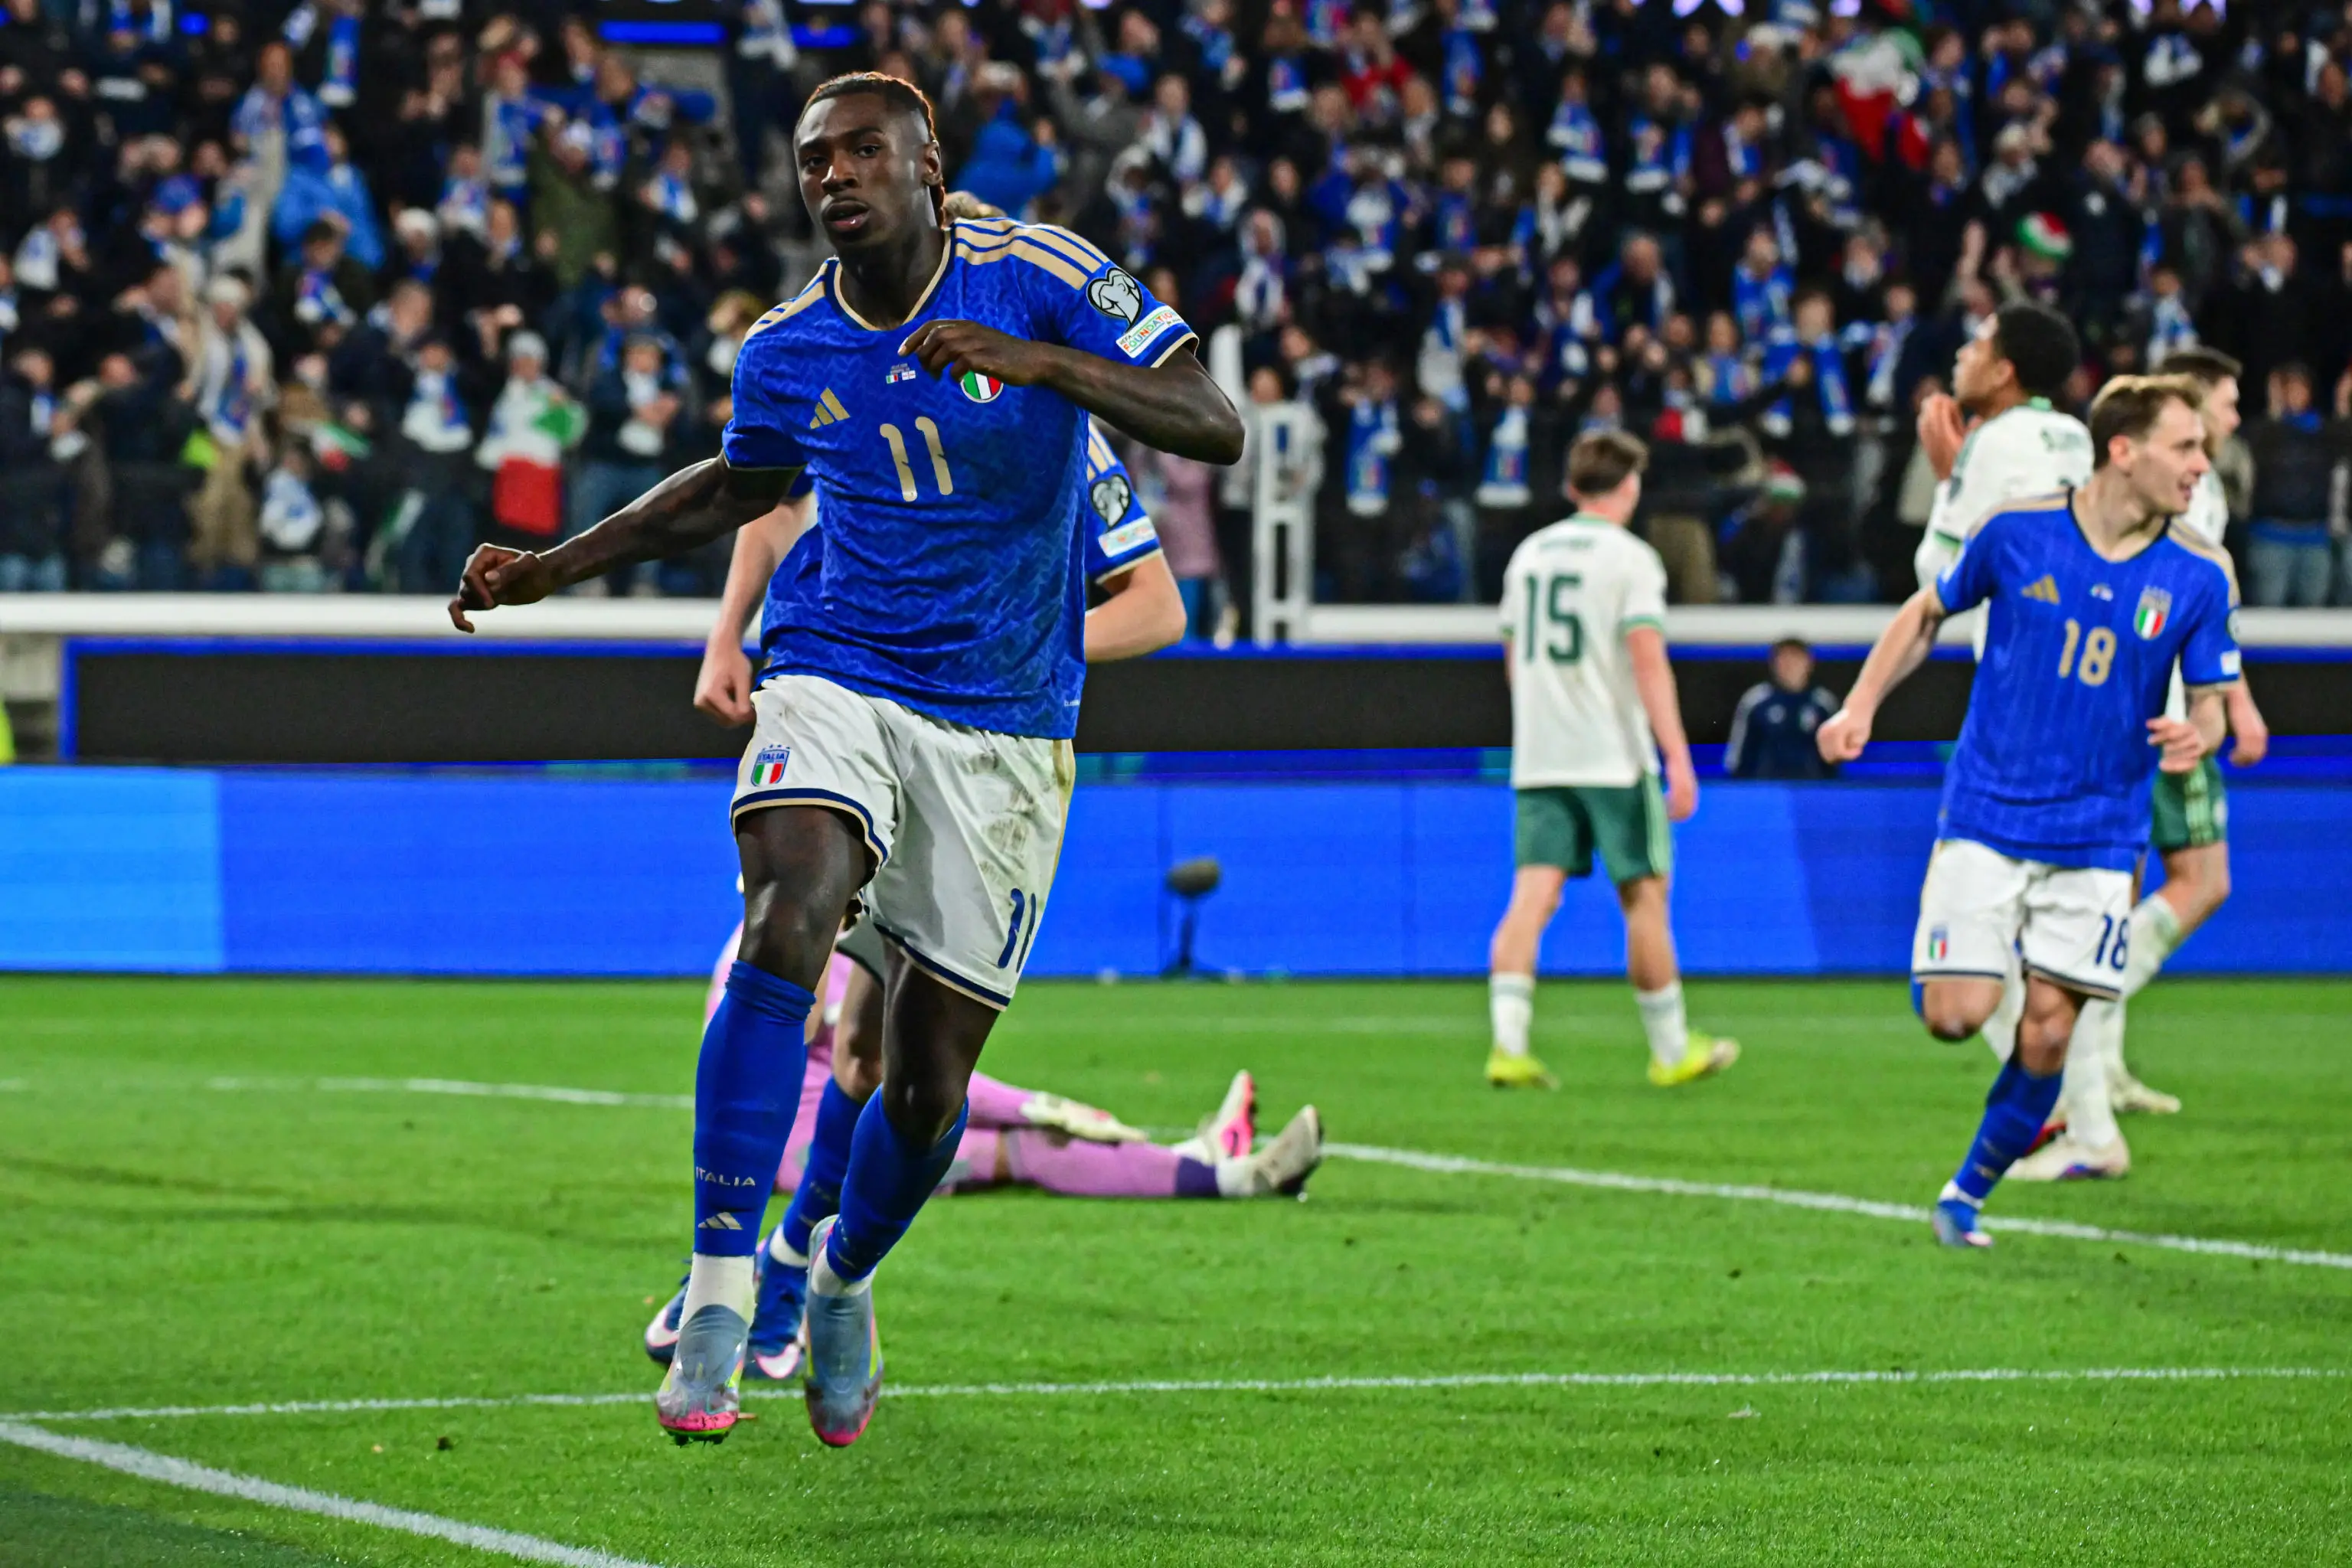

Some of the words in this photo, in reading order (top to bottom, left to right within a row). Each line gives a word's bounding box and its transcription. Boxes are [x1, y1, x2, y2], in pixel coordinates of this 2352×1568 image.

[879, 416, 953, 501] 11
[1525, 572, 1583, 665] 15
[2058, 618, 2117, 686] 18
[998, 888, 1037, 973] 11
[2094, 913, 2128, 972] 18
[695, 1166, 756, 1187] ITALIA
